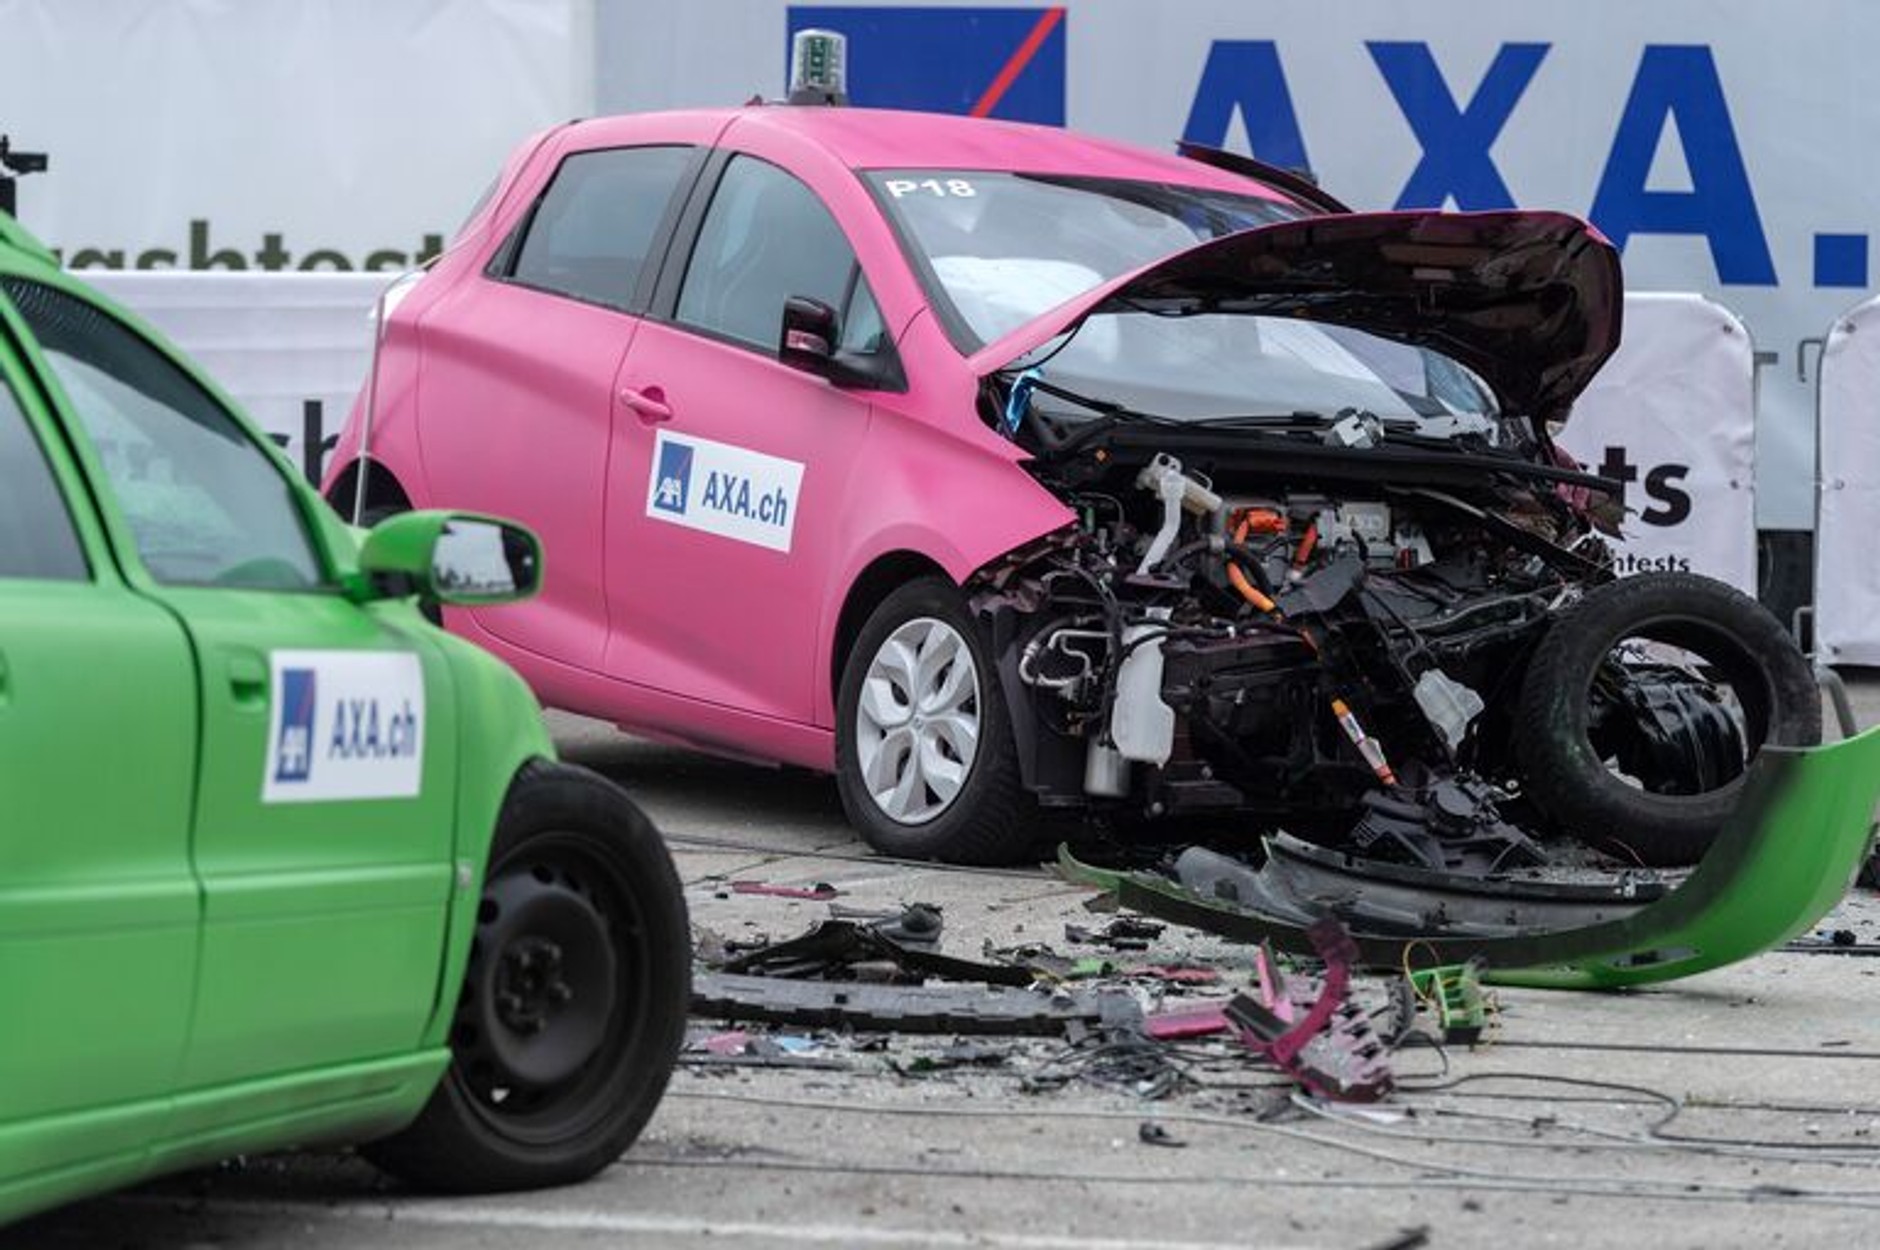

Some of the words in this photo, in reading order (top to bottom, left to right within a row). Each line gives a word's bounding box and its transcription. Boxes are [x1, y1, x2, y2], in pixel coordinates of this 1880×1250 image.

[885, 179, 976, 198] P18
[702, 471, 788, 527] AXA.ch
[1579, 446, 1691, 527] ts
[328, 699, 416, 759] AXA.ch
